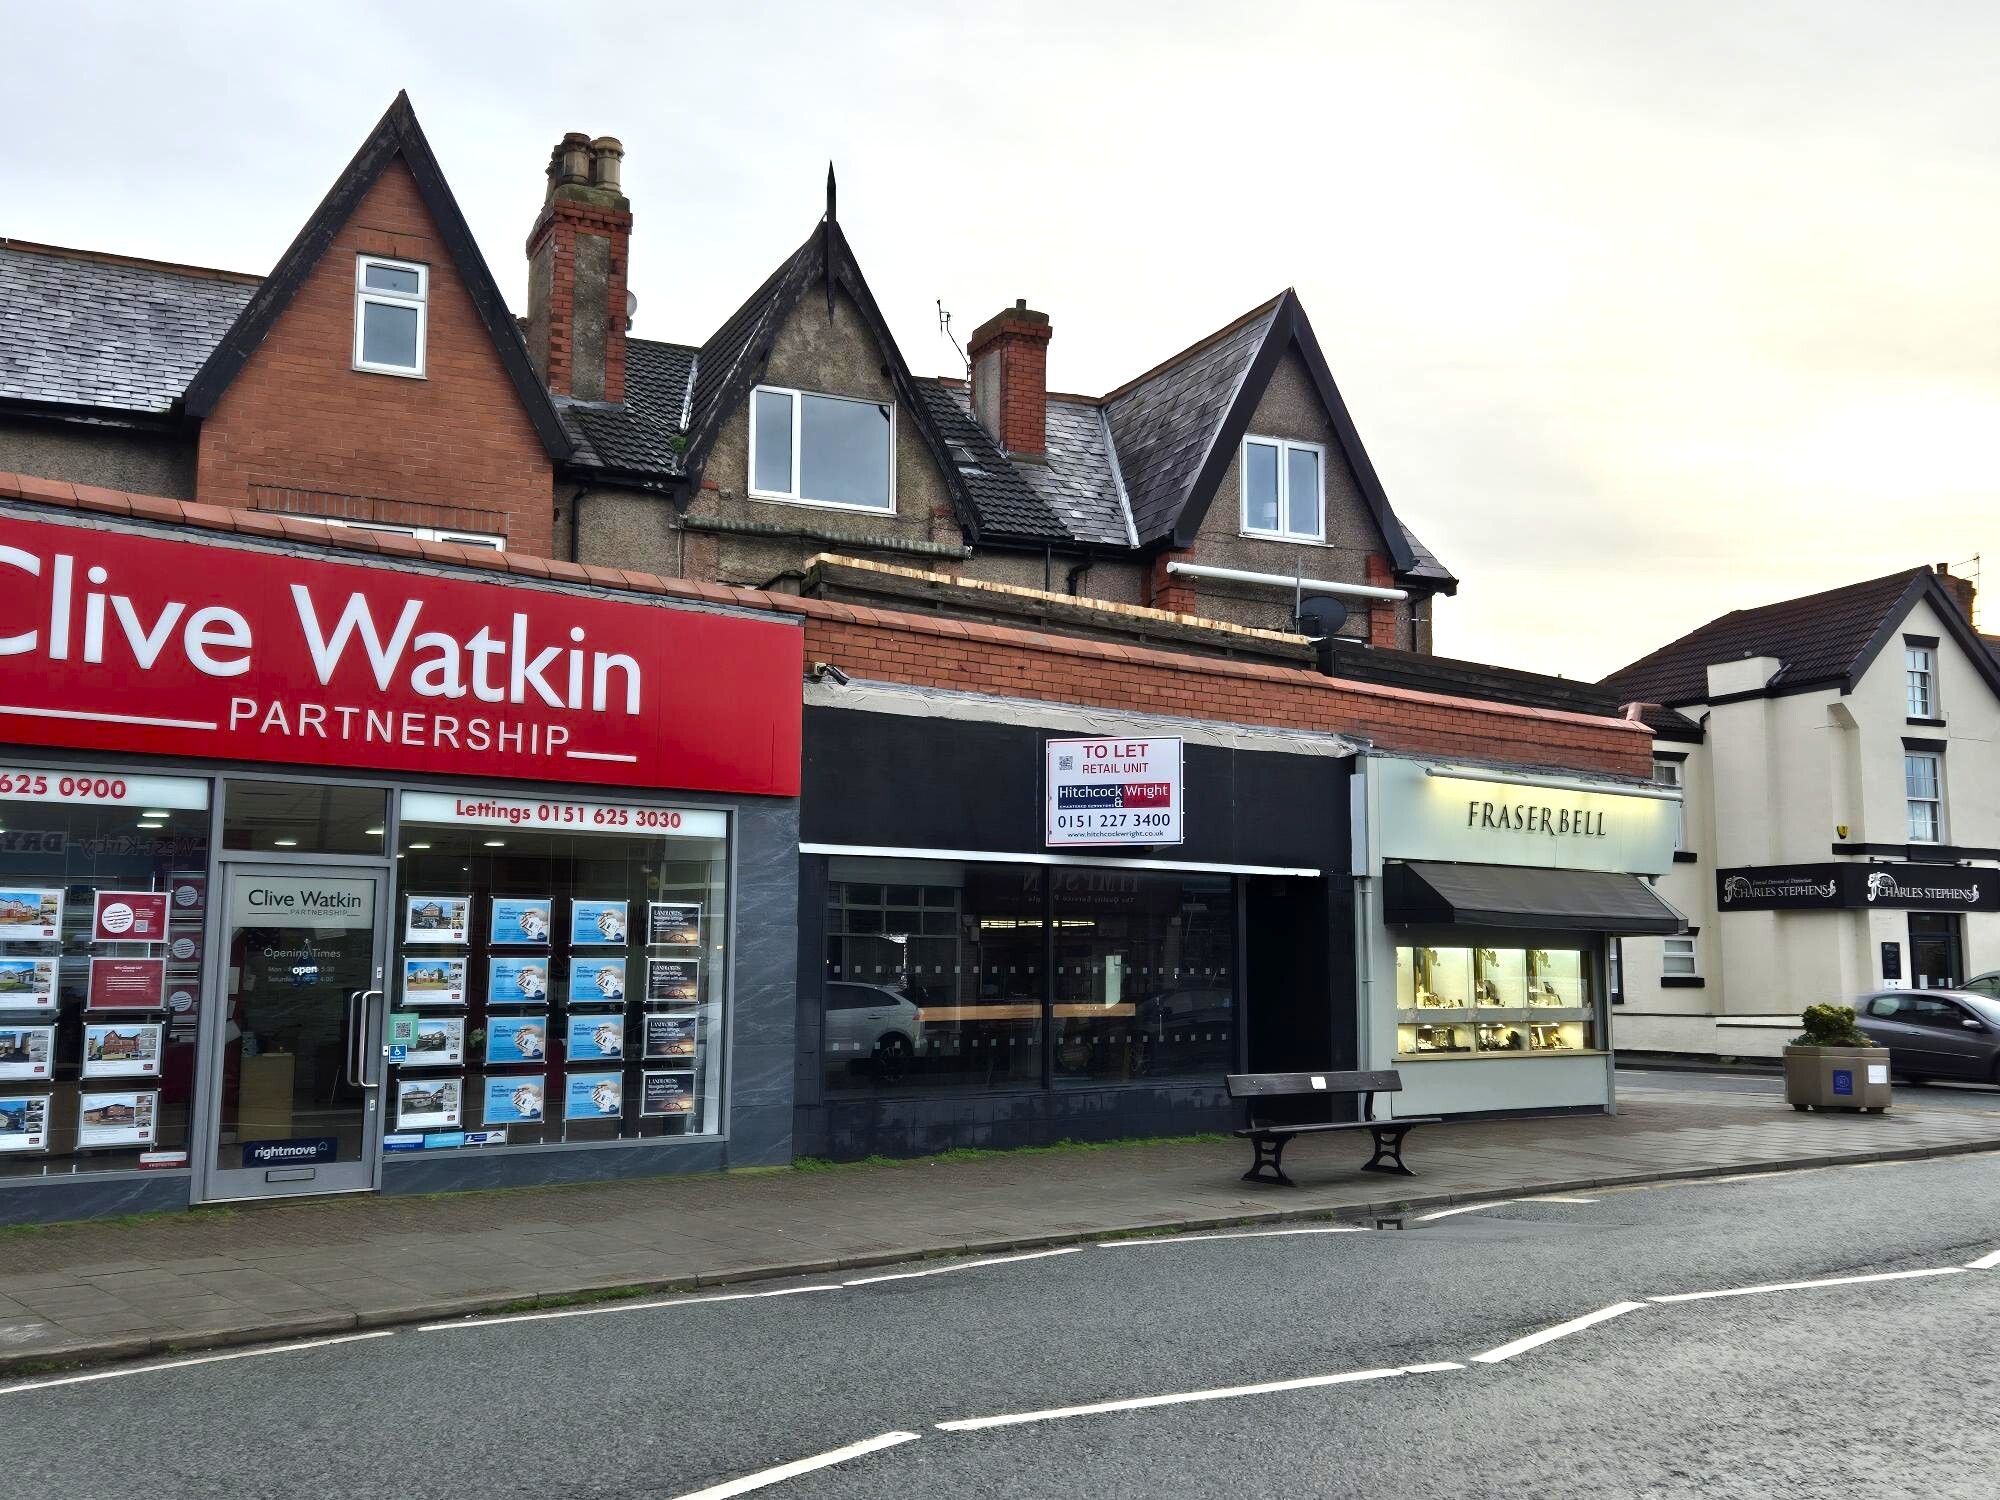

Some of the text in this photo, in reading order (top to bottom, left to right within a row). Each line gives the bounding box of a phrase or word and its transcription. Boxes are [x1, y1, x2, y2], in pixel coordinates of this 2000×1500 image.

[290, 584, 641, 715] Watkin
[229, 697, 570, 756] PARTNERSHIP
[1083, 744, 1149, 758] TO LET
[1082, 763, 1149, 774] RETAIL UNIT
[0, 774, 127, 799] 625 0900
[1059, 784, 1168, 799] Hitchcock Wright
[1114, 797, 1123, 808] &
[456, 799, 682, 829] Lettings 0151 625 3030
[1058, 813, 1171, 828] 0151 227 3400
[1468, 801, 1607, 836] FRASER BELL
[1067, 830, 1164, 838] www.hitchcockwright.co.uk
[248, 889, 361, 908] Clive Watkin
[1733, 885, 1829, 898] CHARLES STEPHENS
[1878, 886, 1973, 899] CHARLES STEPHENS
[264, 947, 341, 960] Opening Times
[292, 966, 318, 976] open
[255, 1145, 317, 1160] rightmove
